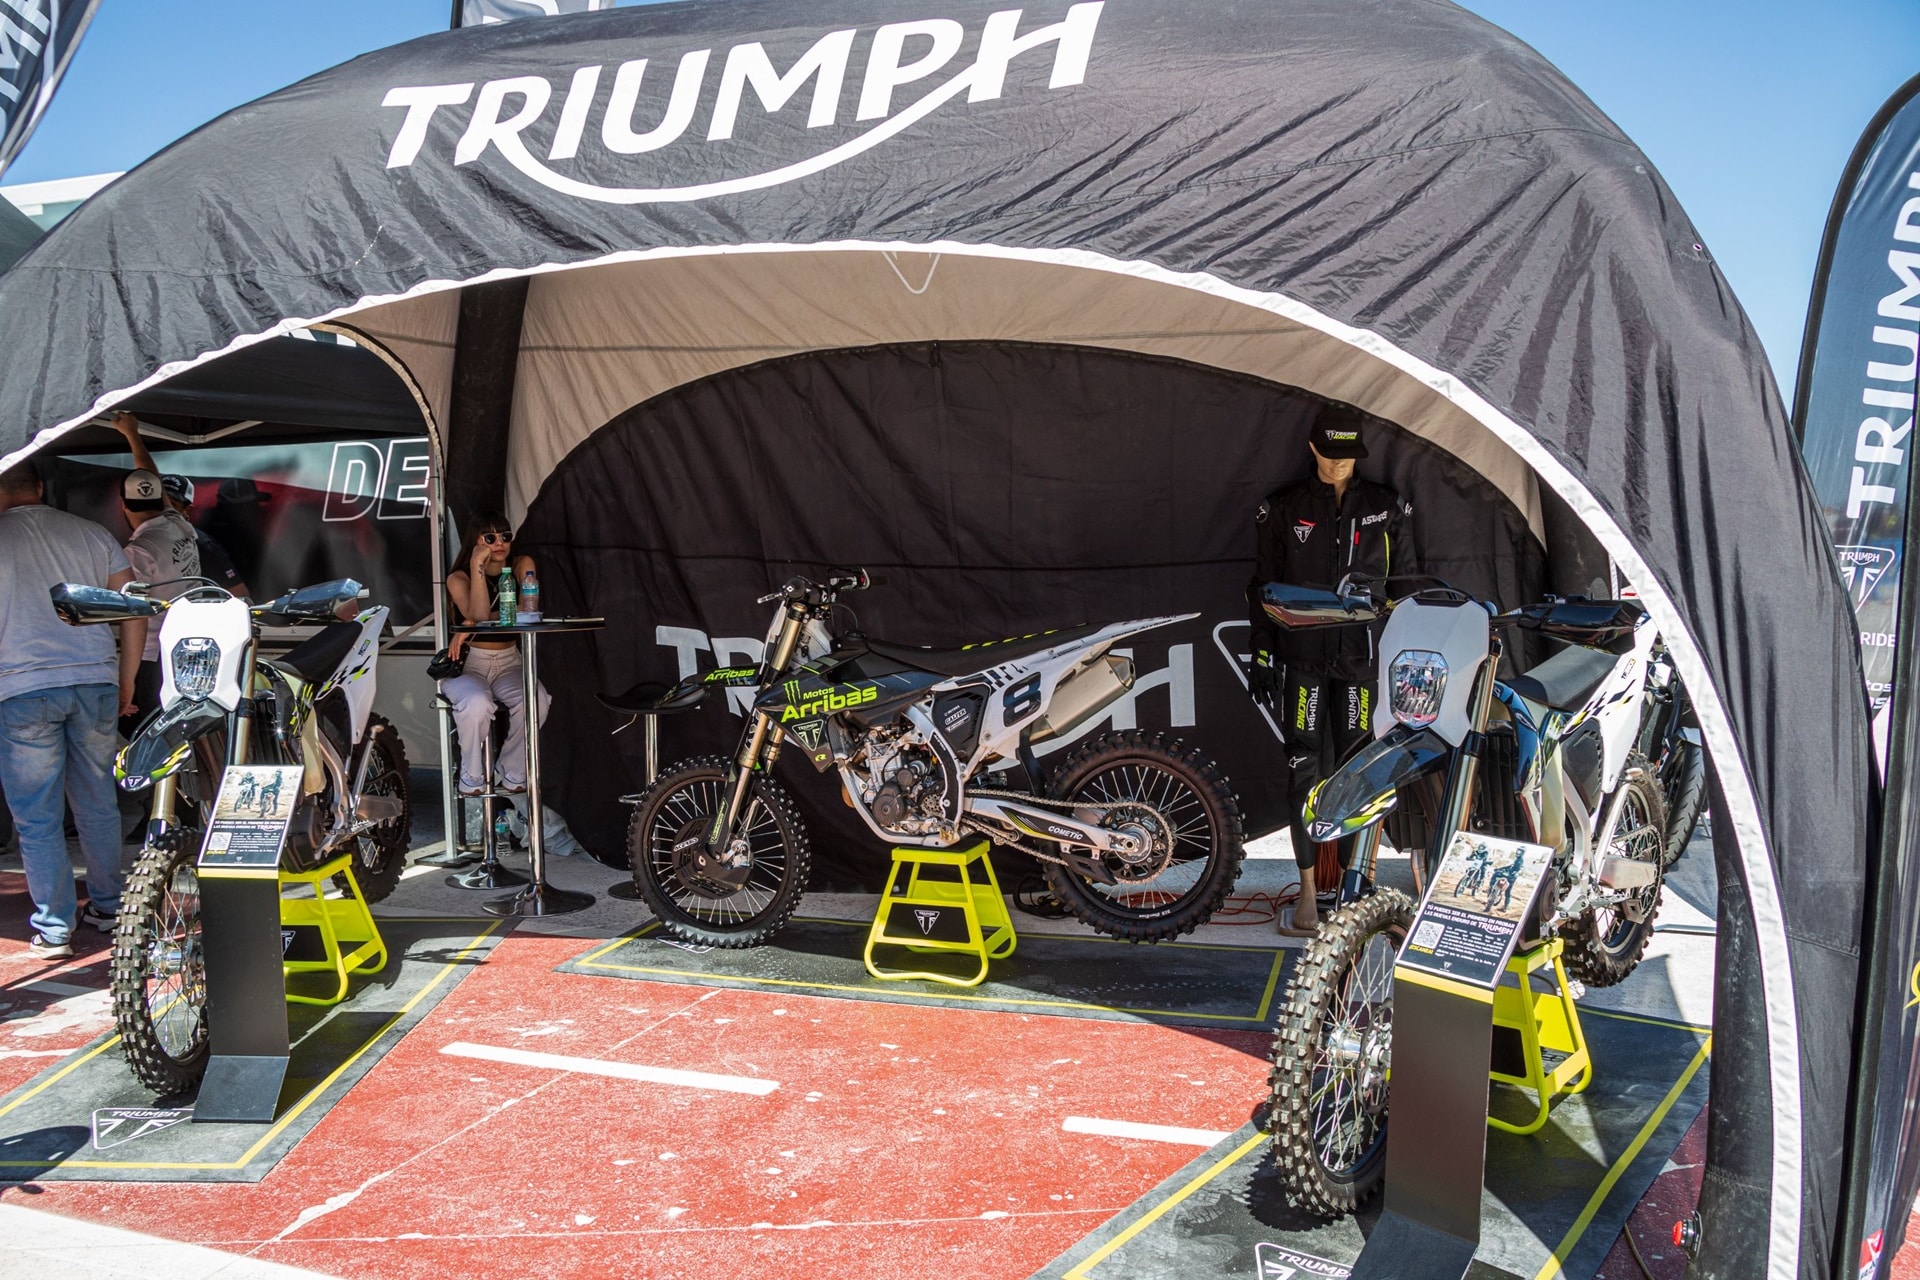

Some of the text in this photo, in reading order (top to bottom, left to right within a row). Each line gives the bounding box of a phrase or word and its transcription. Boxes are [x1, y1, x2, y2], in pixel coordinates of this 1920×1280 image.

[382, 0, 1104, 204] TRIUMPH
[1846, 172, 1920, 519] TRIUMP
[322, 438, 432, 522] DE
[1839, 551, 1881, 566] TRIUMPH
[1860, 631, 1896, 648] RIDE
[704, 668, 756, 682] Arribas
[803, 687, 835, 700] Motos
[781, 686, 877, 723] Arribas
[1003, 671, 1042, 728] 8
[1296, 685, 1308, 731] RACING
[1306, 685, 1320, 731] TRIUMPH
[1348, 686, 1360, 730] TRIUMPH
[1360, 686, 1369, 731] RACING
[1047, 825, 1084, 841] COMETIC
[1477, 922, 1513, 935] TRIUMPH
[112, 1110, 181, 1120] TRIUMPH
[1278, 1251, 1352, 1278] TRIUMP
